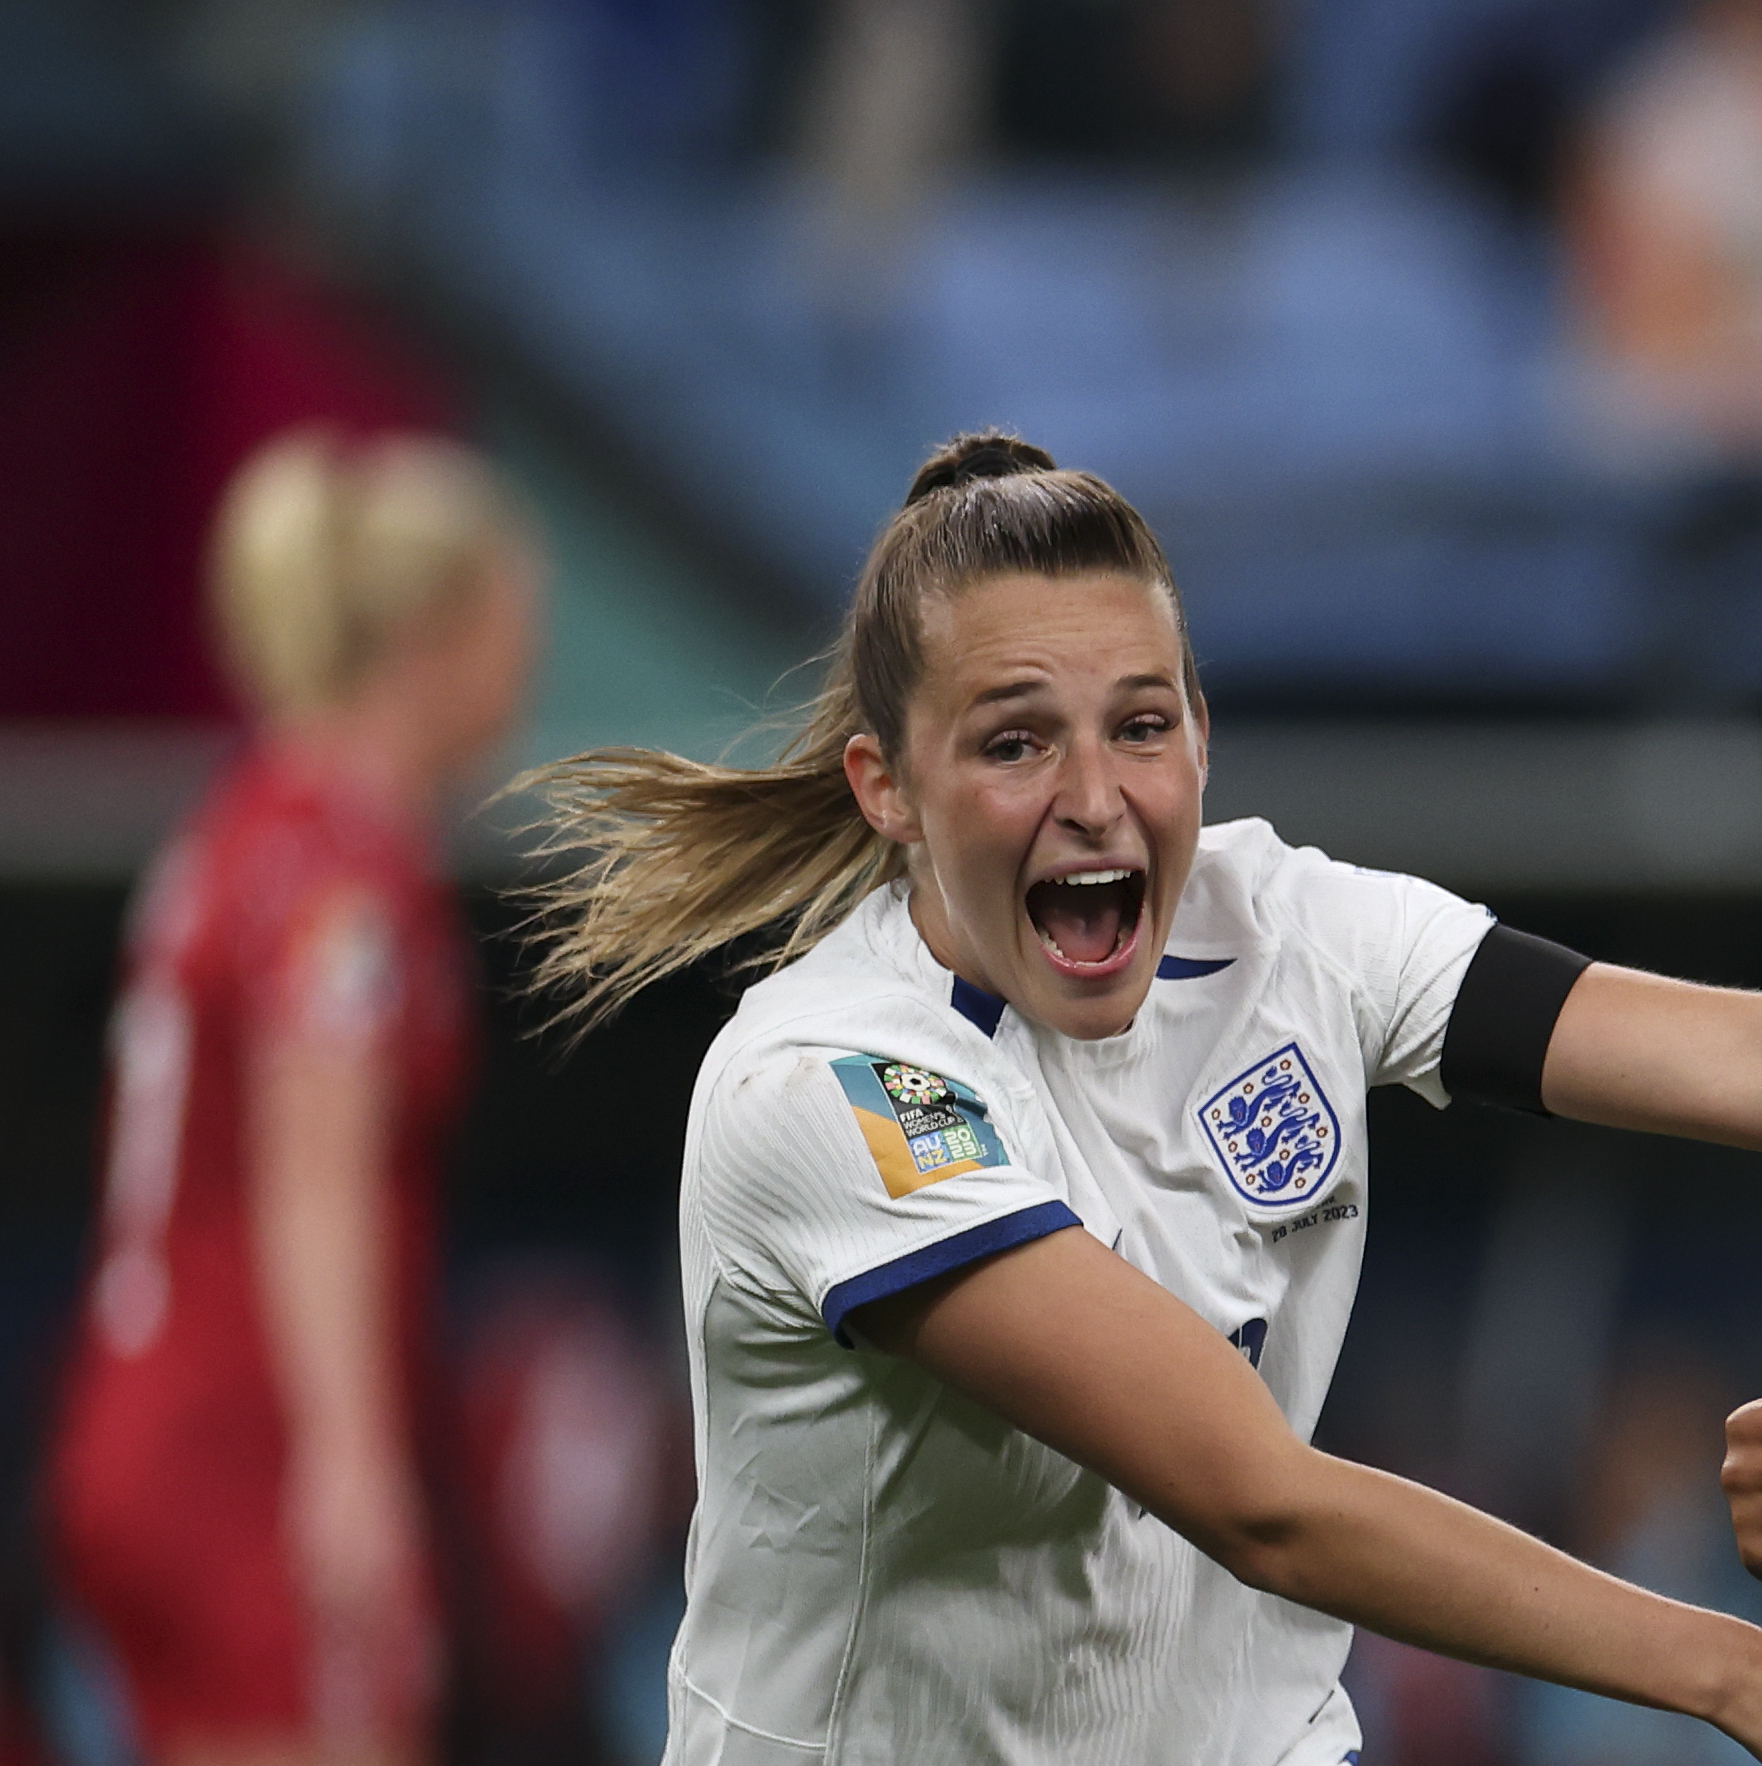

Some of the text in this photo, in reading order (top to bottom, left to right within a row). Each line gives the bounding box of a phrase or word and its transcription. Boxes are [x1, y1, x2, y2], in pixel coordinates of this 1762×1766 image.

[900, 1108, 924, 1122] FIFA
[903, 1111, 946, 1129] WOMEN'S
[906, 1116, 956, 1137] WORLD CUP
[943, 1127, 971, 1145] 20
[913, 1135, 942, 1156] AU
[949, 1141, 977, 1161] 23
[917, 1148, 948, 1169] NZ
[1291, 1213, 1318, 1233] JULY
[1322, 1204, 1359, 1222] 2023
